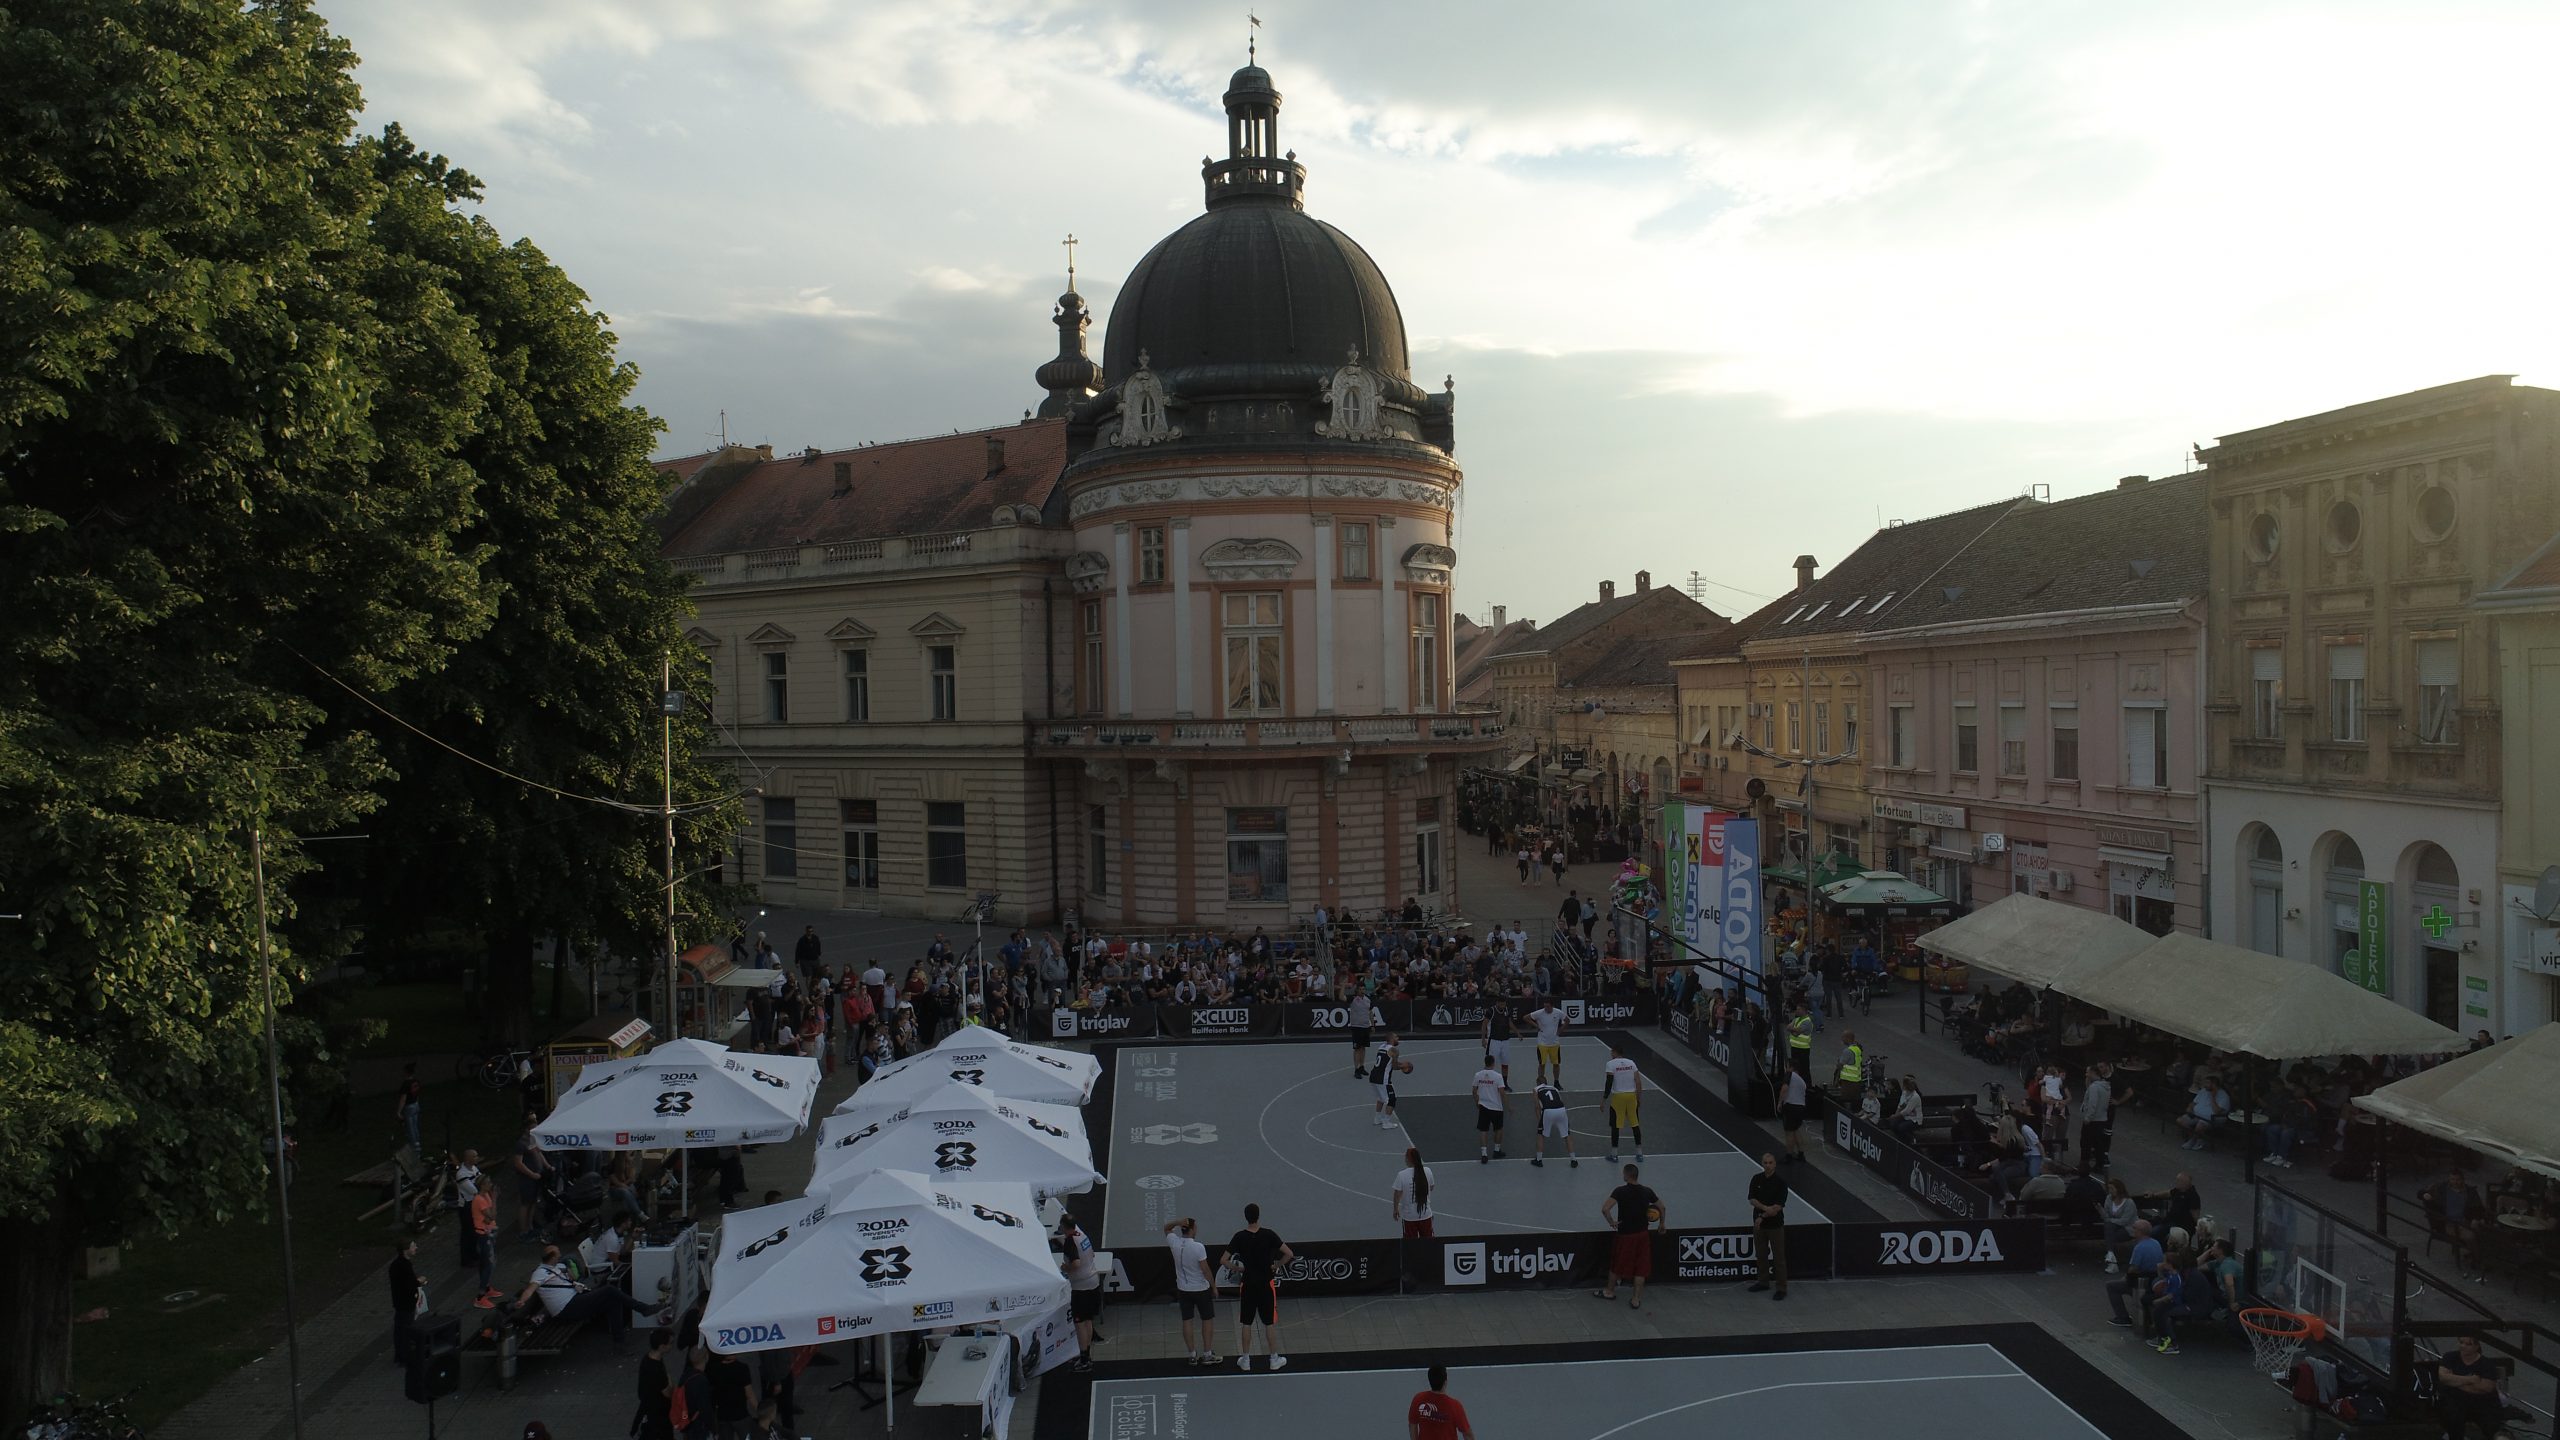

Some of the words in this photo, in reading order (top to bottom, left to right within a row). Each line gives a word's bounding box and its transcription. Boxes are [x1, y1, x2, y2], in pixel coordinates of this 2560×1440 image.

[1883, 804, 1913, 819] fortuna
[2367, 885, 2378, 989] APOTEKA
[1311, 1008, 1386, 1028] ROA
[1454, 1006, 1487, 1026] LAŠ
[1588, 1002, 1635, 1021] triglav
[1080, 1014, 1130, 1033] triglav
[1192, 1027, 1227, 1035] Raiffeisen
[1708, 1034, 1729, 1066] ROD
[952, 1054, 988, 1062] RODA
[660, 1072, 699, 1081] RODA
[1545, 1089, 1554, 1101] 1
[933, 1120, 976, 1130] RODA
[544, 1135, 592, 1147] RODA
[630, 1133, 656, 1143] triglav
[1851, 1127, 1882, 1162] triglav
[940, 1166, 972, 1175] SERBIA
[856, 1218, 910, 1234] RODA
[862, 1227, 905, 1238] PRVENSTVO
[1878, 1228, 2005, 1266] RODA
[1273, 1256, 1352, 1284] AŠKO
[1359, 1257, 1368, 1279] 1825
[1491, 1247, 1574, 1279] triglav
[1679, 1265, 1739, 1277] Raiffeisen
[866, 1279, 907, 1289] SERBIA
[838, 1315, 872, 1329] triglav
[718, 1323, 785, 1347] RODA
